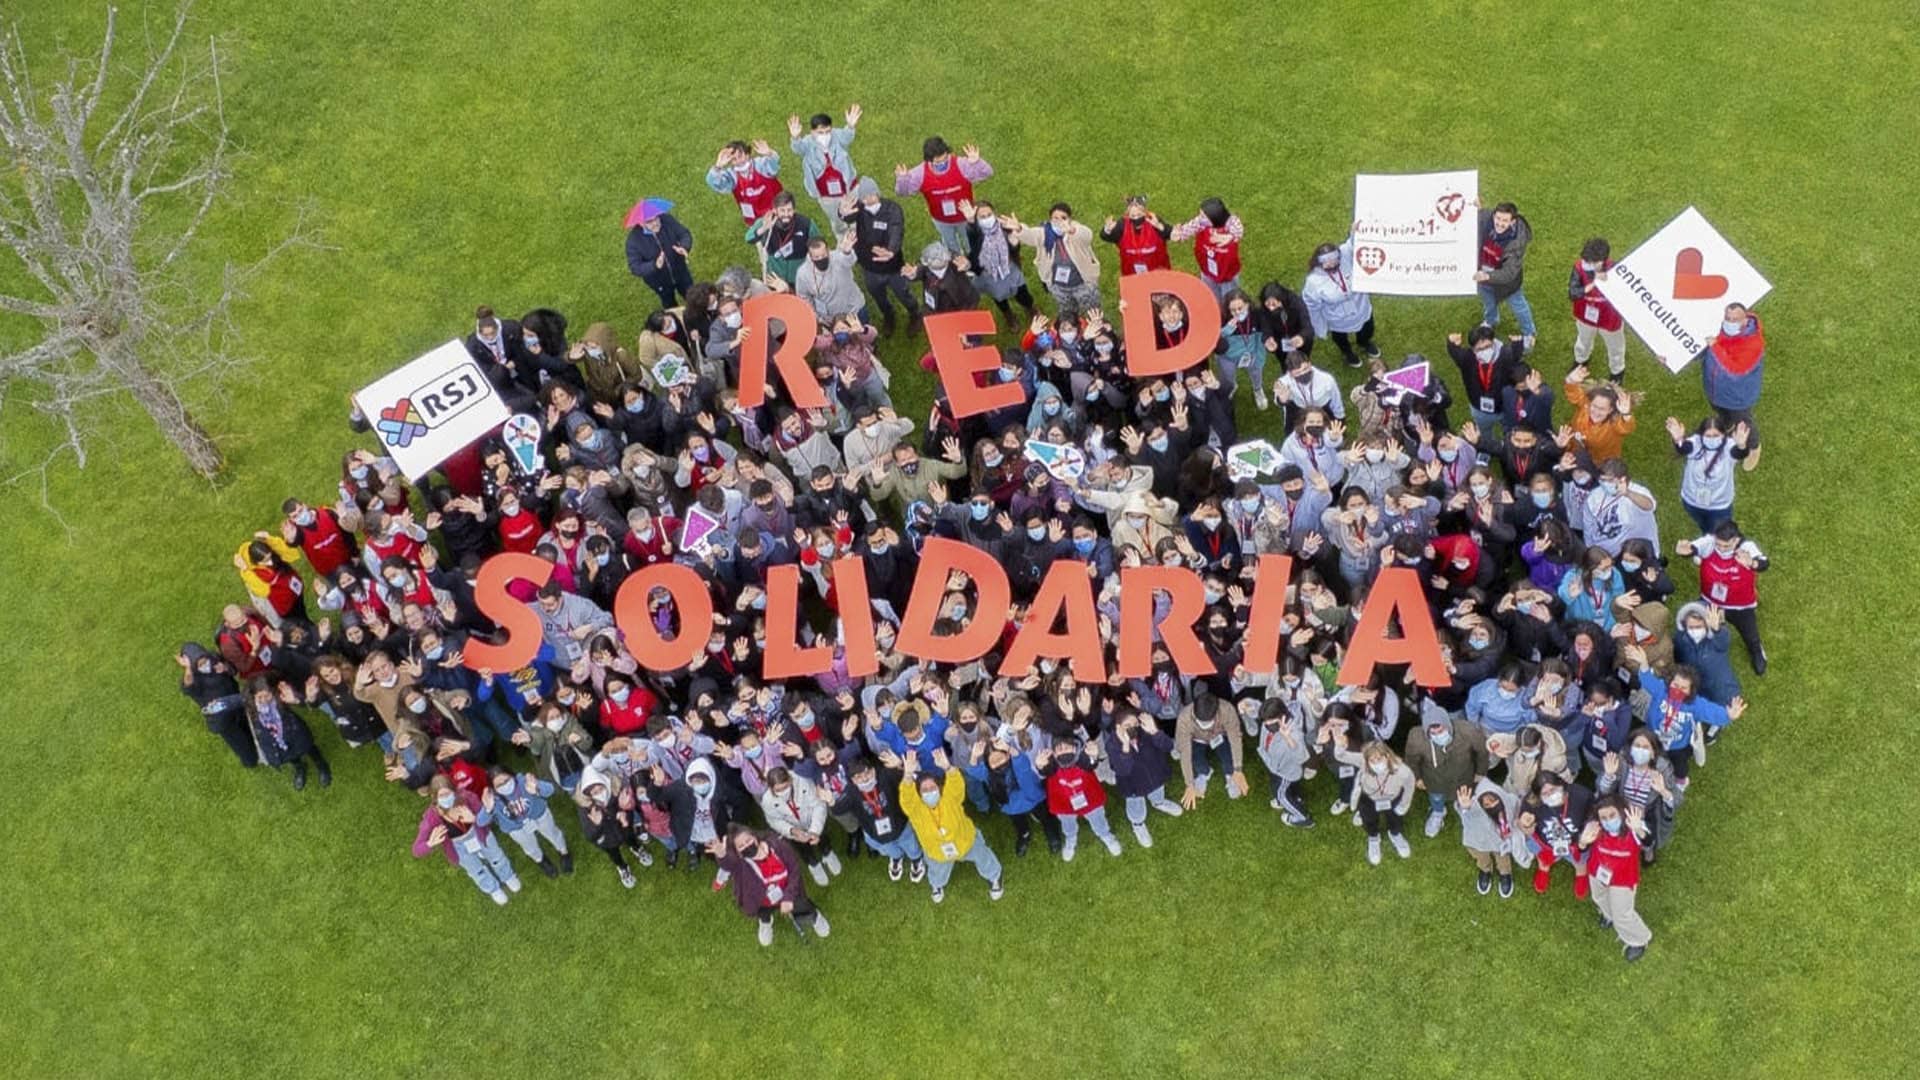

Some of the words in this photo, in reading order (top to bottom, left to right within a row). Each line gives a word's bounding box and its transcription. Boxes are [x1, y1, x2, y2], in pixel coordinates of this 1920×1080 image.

[738, 270, 1223, 418] RED
[1615, 263, 1701, 355] entreculturas
[421, 374, 478, 418] RSJ
[463, 536, 1452, 687] SOLIDARIA
